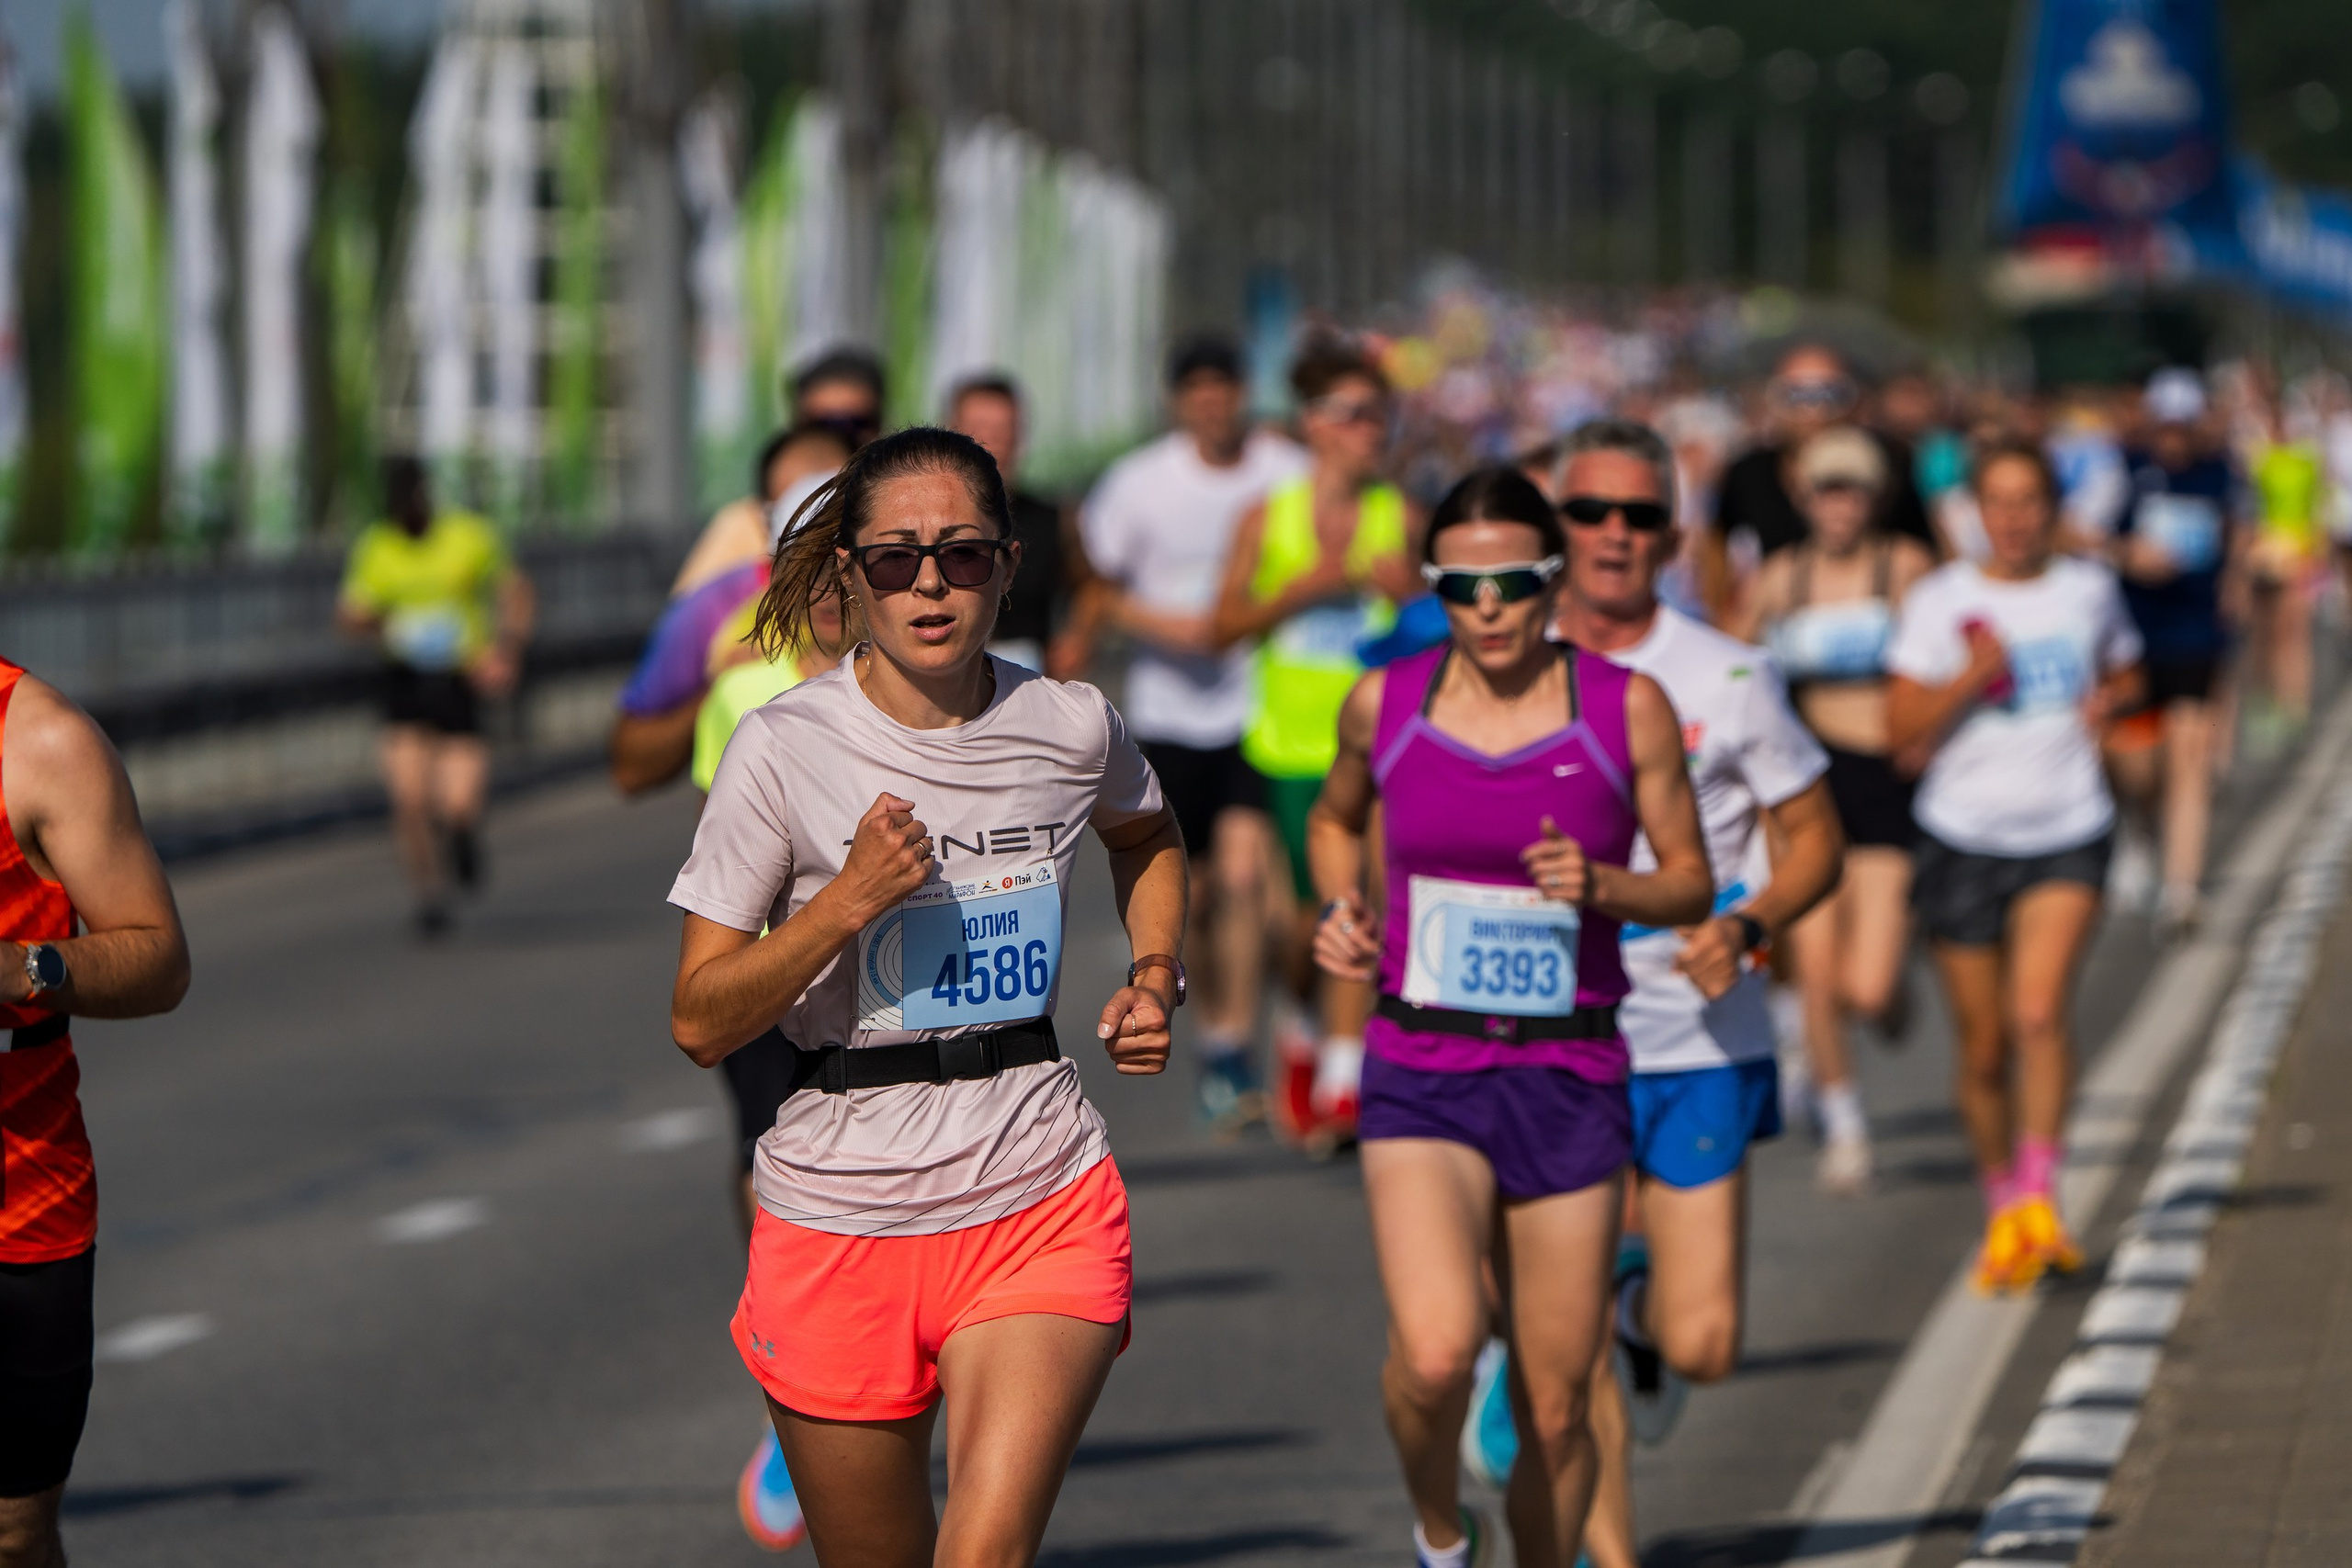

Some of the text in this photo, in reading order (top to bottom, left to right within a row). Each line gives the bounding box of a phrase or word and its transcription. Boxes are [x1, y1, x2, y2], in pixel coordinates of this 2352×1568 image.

[843, 821, 1066, 860] NET
[907, 893, 933, 902] СПОРТ
[1015, 874, 1032, 886] Пэй
[962, 910, 1019, 942] ЮЛИЯ
[932, 939, 1048, 1007] 4586
[1460, 945, 1560, 998] 3393
